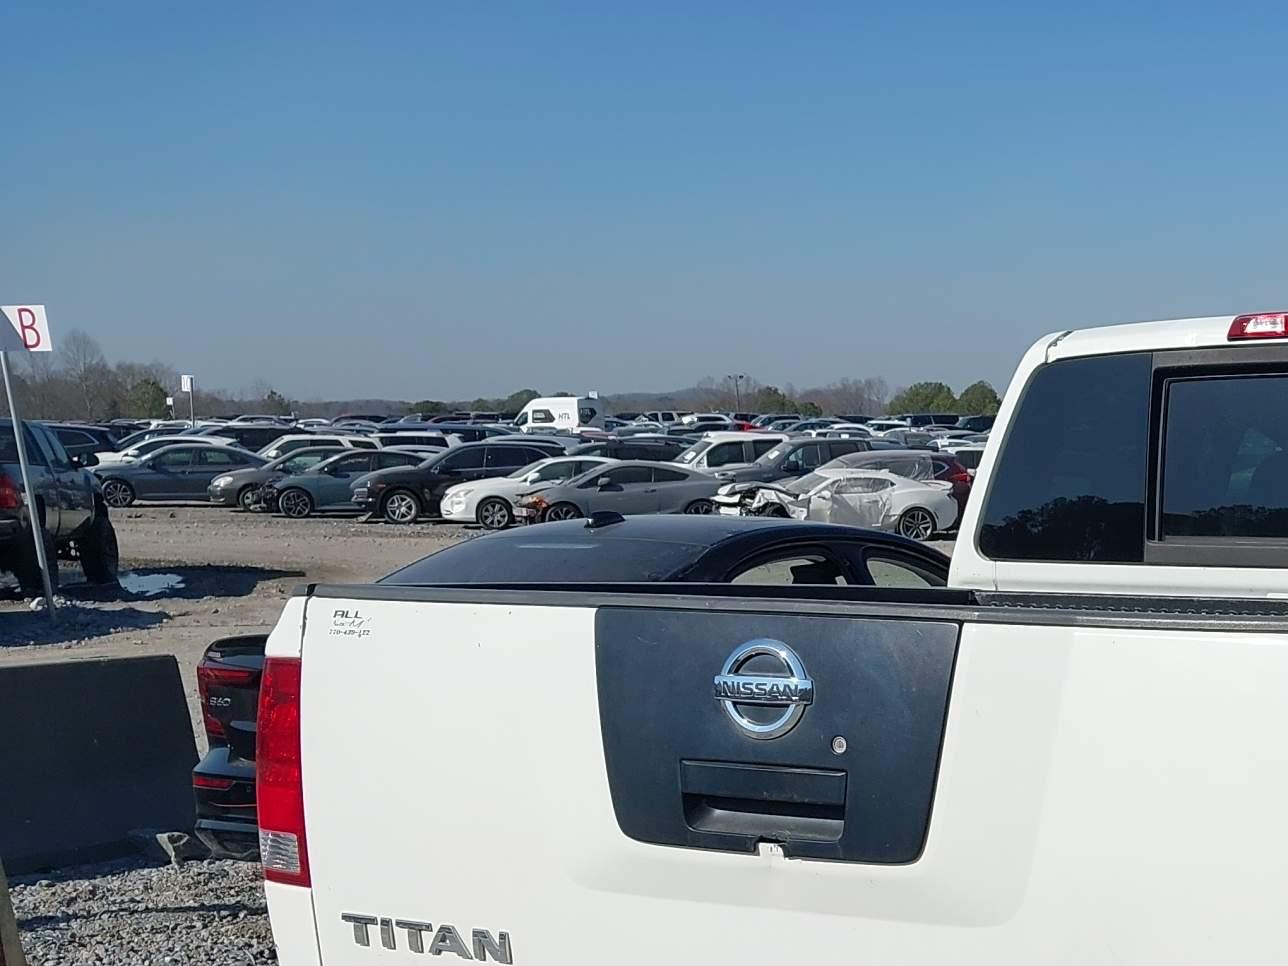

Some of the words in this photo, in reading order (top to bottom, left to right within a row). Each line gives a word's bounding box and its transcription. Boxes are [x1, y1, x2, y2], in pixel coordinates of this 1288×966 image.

[17, 307, 41, 349] B
[333, 610, 363, 619] ALL
[721, 680, 800, 699] NISSAN
[341, 912, 513, 965] TITAN
